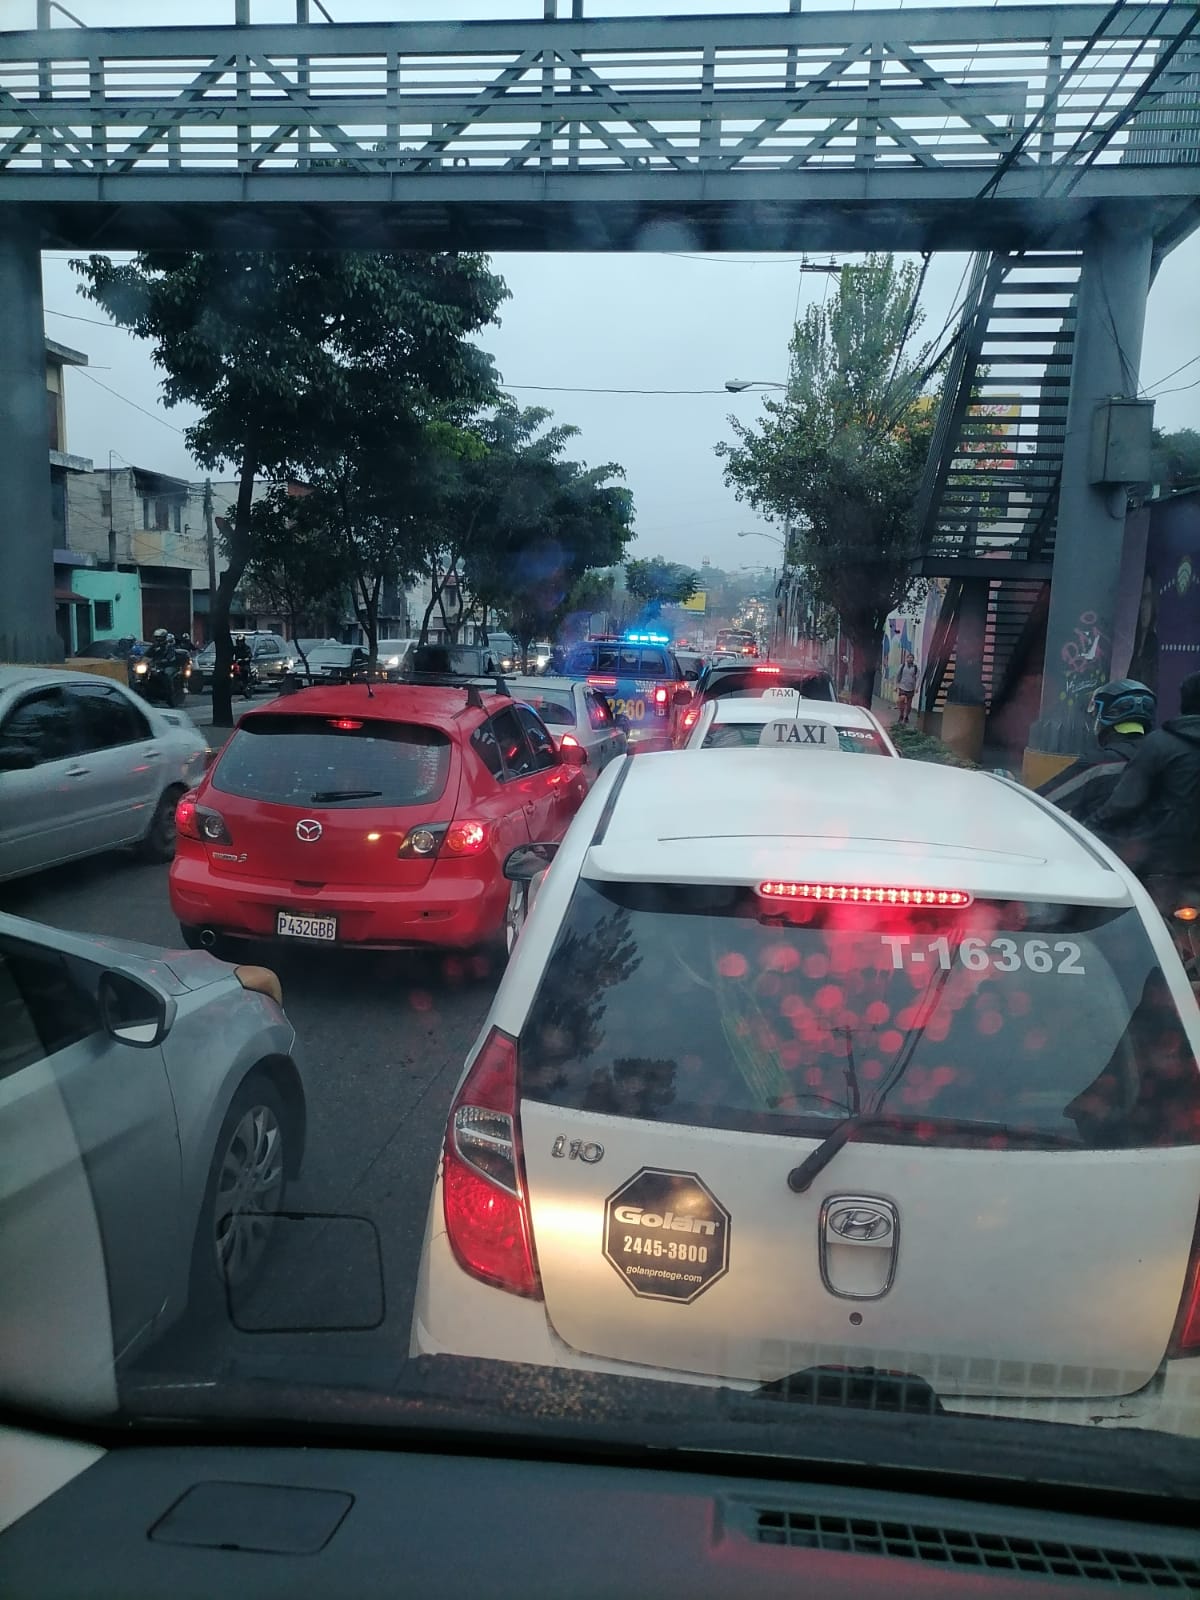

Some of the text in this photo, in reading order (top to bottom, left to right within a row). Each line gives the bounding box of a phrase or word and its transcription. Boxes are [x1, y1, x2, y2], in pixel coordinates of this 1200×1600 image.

[770, 688, 794, 698] TAXI
[773, 723, 828, 745] TAXI
[279, 917, 335, 939] P432GBB
[880, 935, 1086, 975] T-16362
[623, 1235, 708, 1264] 2445-3800
[626, 1265, 703, 1283] golanprotege.com
